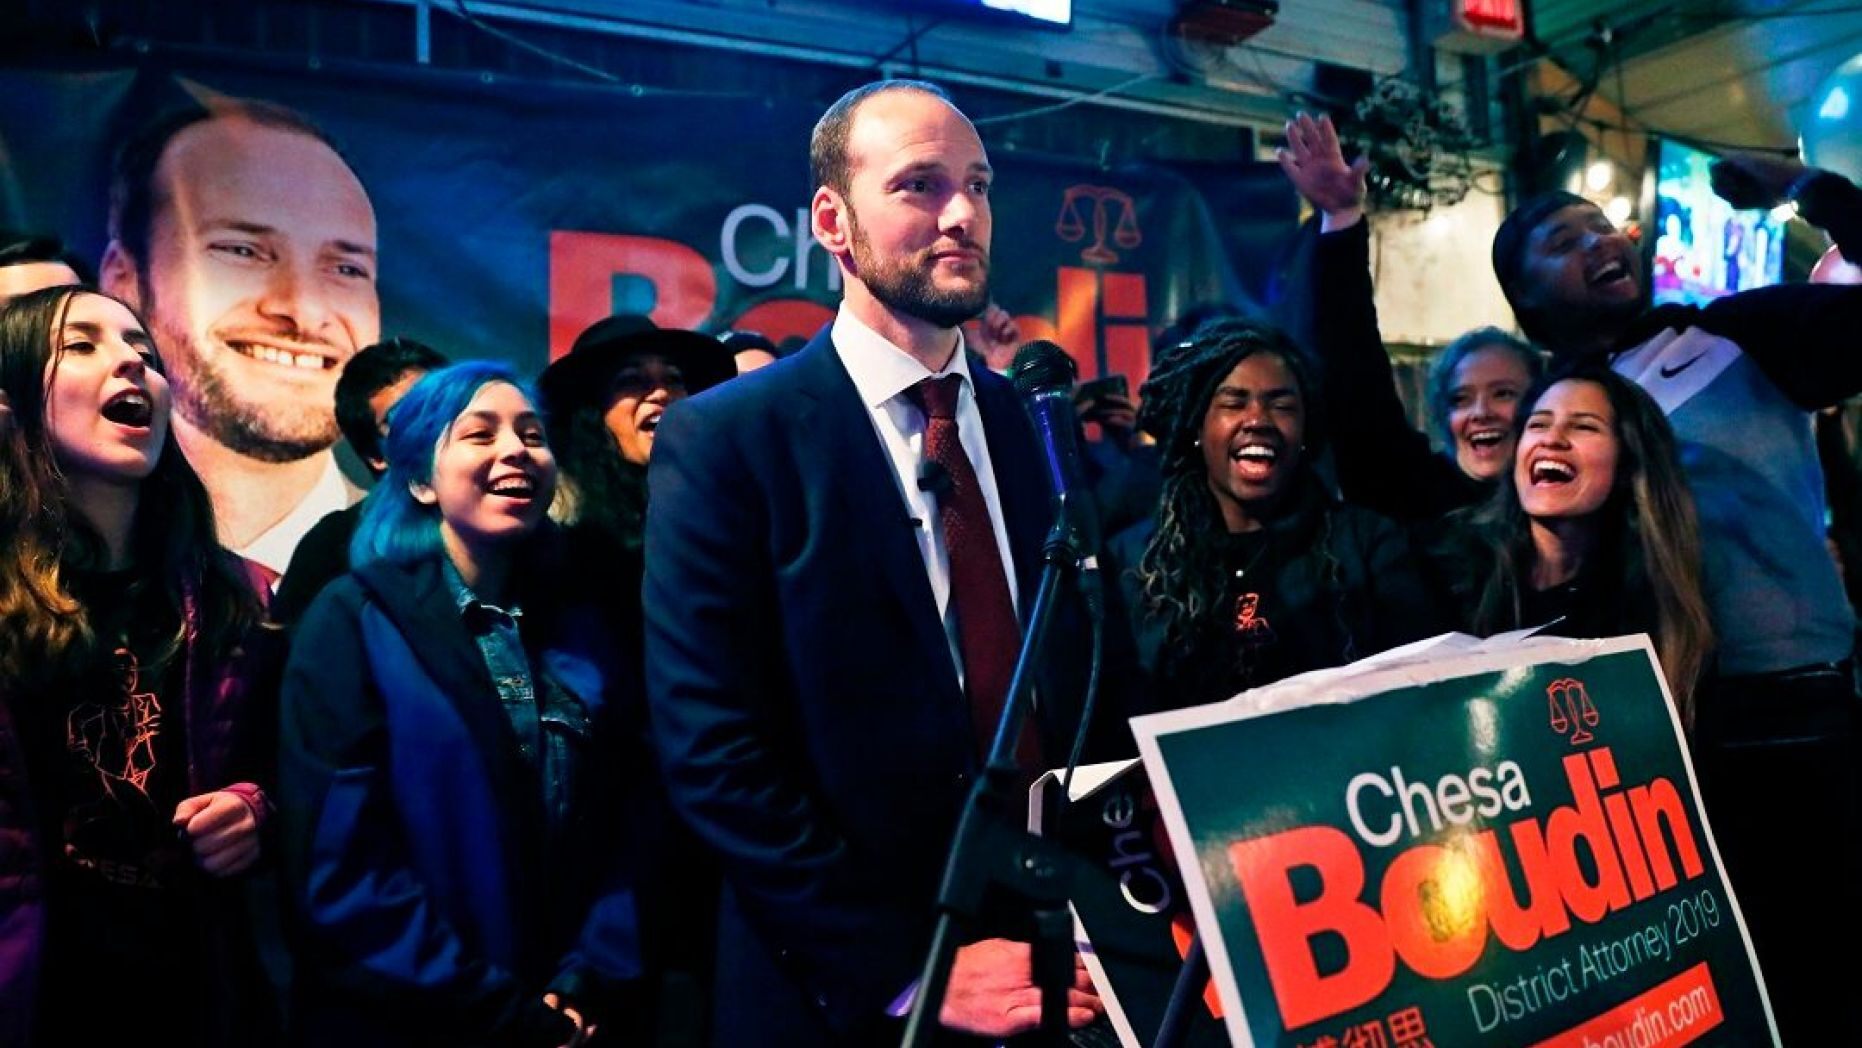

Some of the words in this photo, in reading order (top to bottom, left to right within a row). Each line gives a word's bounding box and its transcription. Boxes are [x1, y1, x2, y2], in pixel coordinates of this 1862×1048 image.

[1102, 790, 1171, 914] Che
[1346, 759, 1532, 847] Chesa
[1228, 748, 1705, 1032] Boudin
[1467, 957, 1579, 1034] District
[1580, 917, 1672, 990] Attorney
[1667, 888, 1721, 945] 2019
